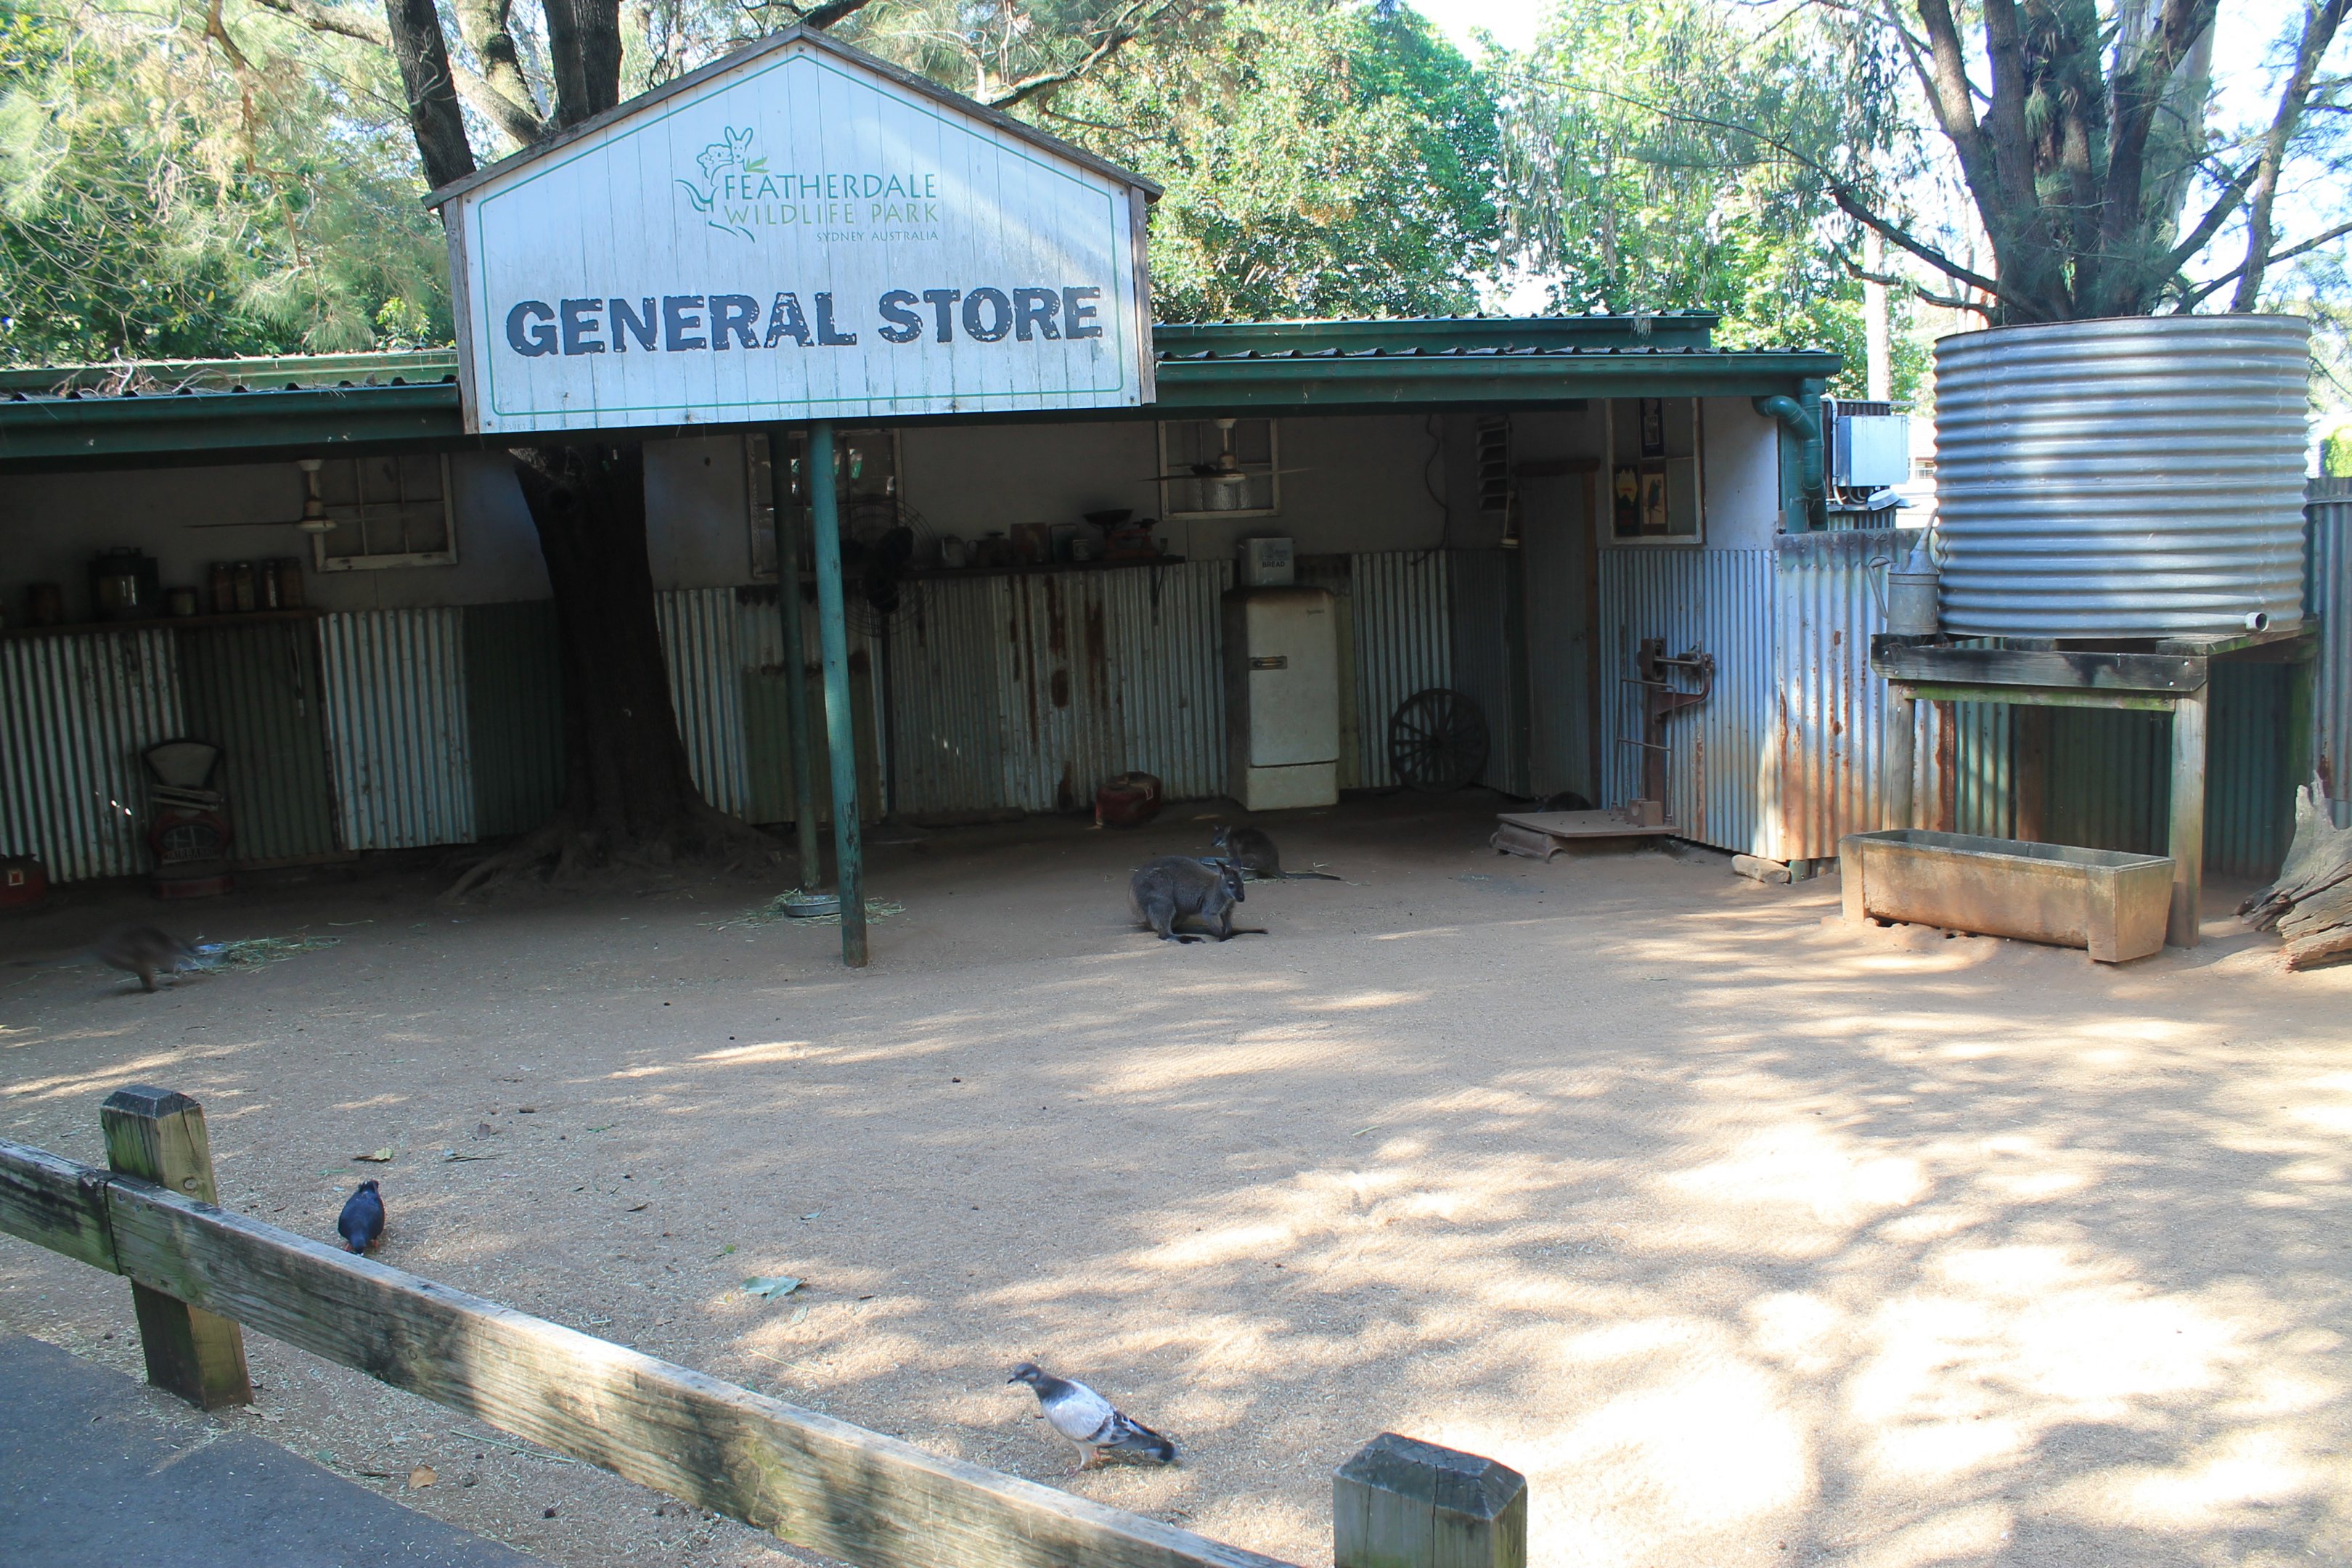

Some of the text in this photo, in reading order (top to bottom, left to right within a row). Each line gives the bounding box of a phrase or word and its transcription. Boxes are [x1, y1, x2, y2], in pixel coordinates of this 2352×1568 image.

[724, 173, 937, 200] FEATHERDALE
[724, 203, 939, 225] WILDLIFE PARK
[817, 230, 939, 242] SYDNEY AUSTRALIA
[506, 286, 1104, 357] GENERAL STORE
